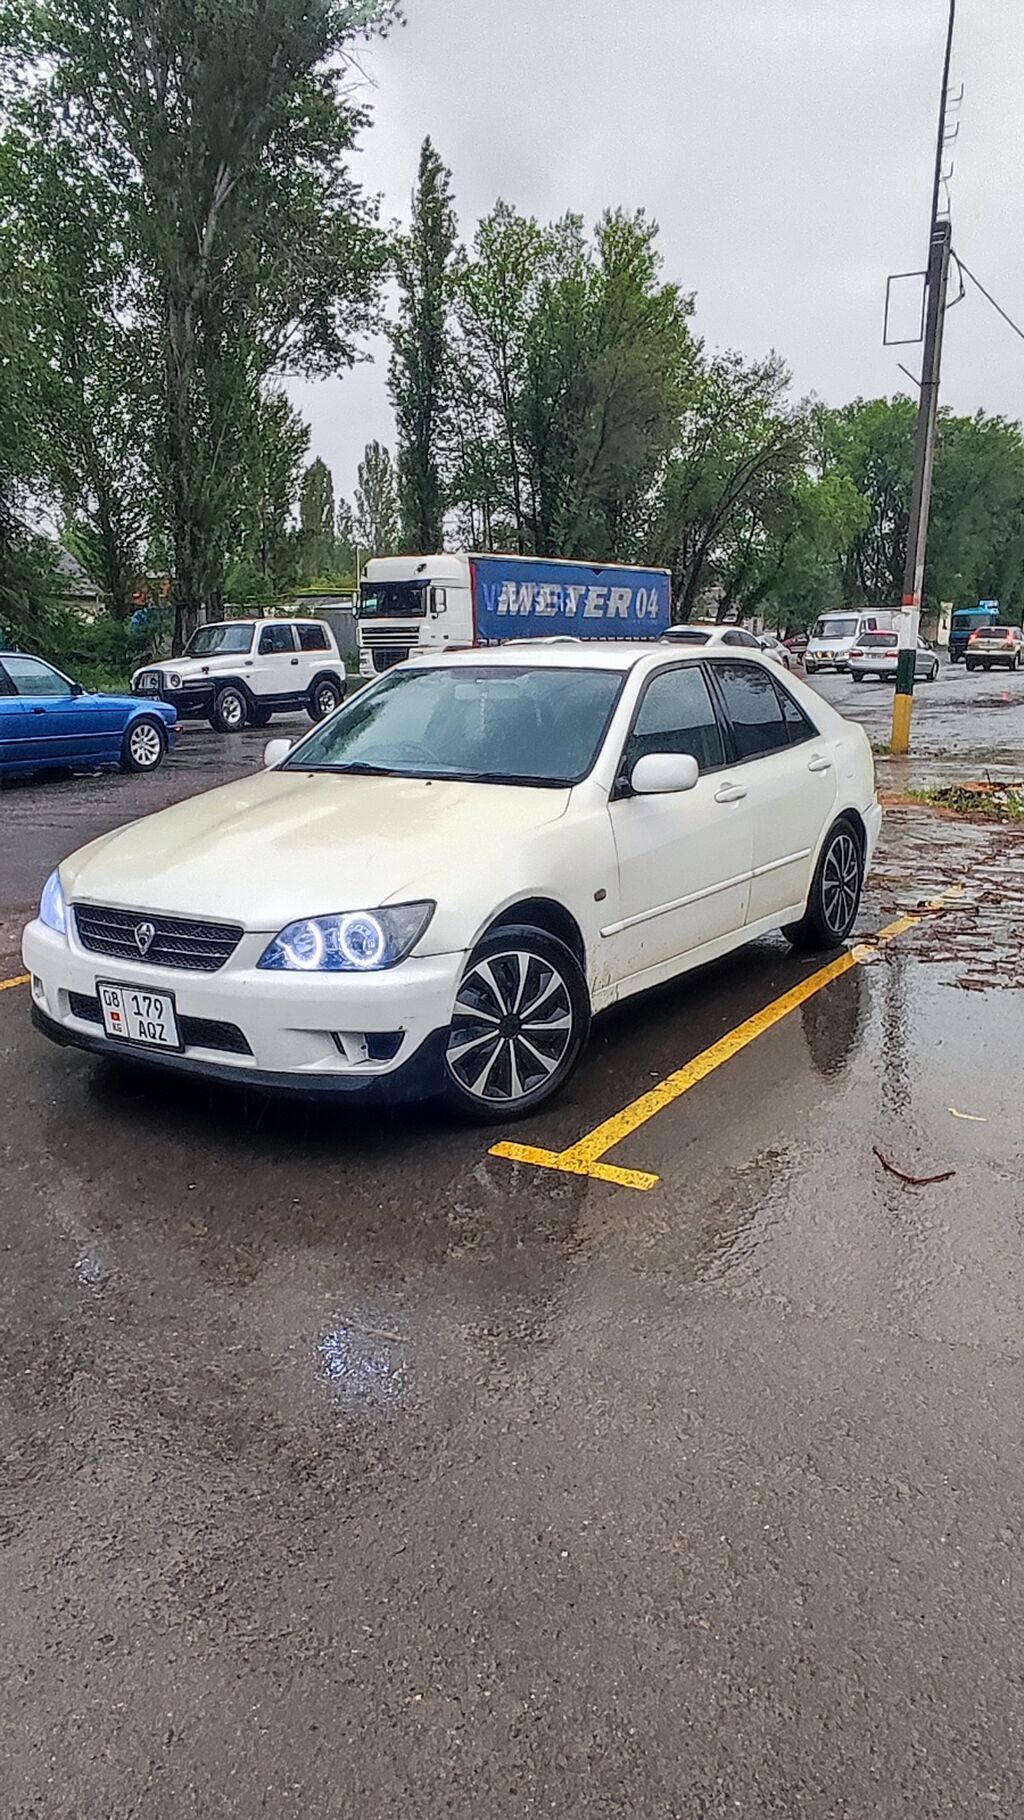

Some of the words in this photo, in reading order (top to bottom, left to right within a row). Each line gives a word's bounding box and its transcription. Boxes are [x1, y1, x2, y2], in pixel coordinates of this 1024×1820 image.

[635, 587, 659, 619] 04
[131, 994, 164, 1020] 179
[112, 1022, 122, 1033] KG
[139, 1019, 168, 1042] AQZ
